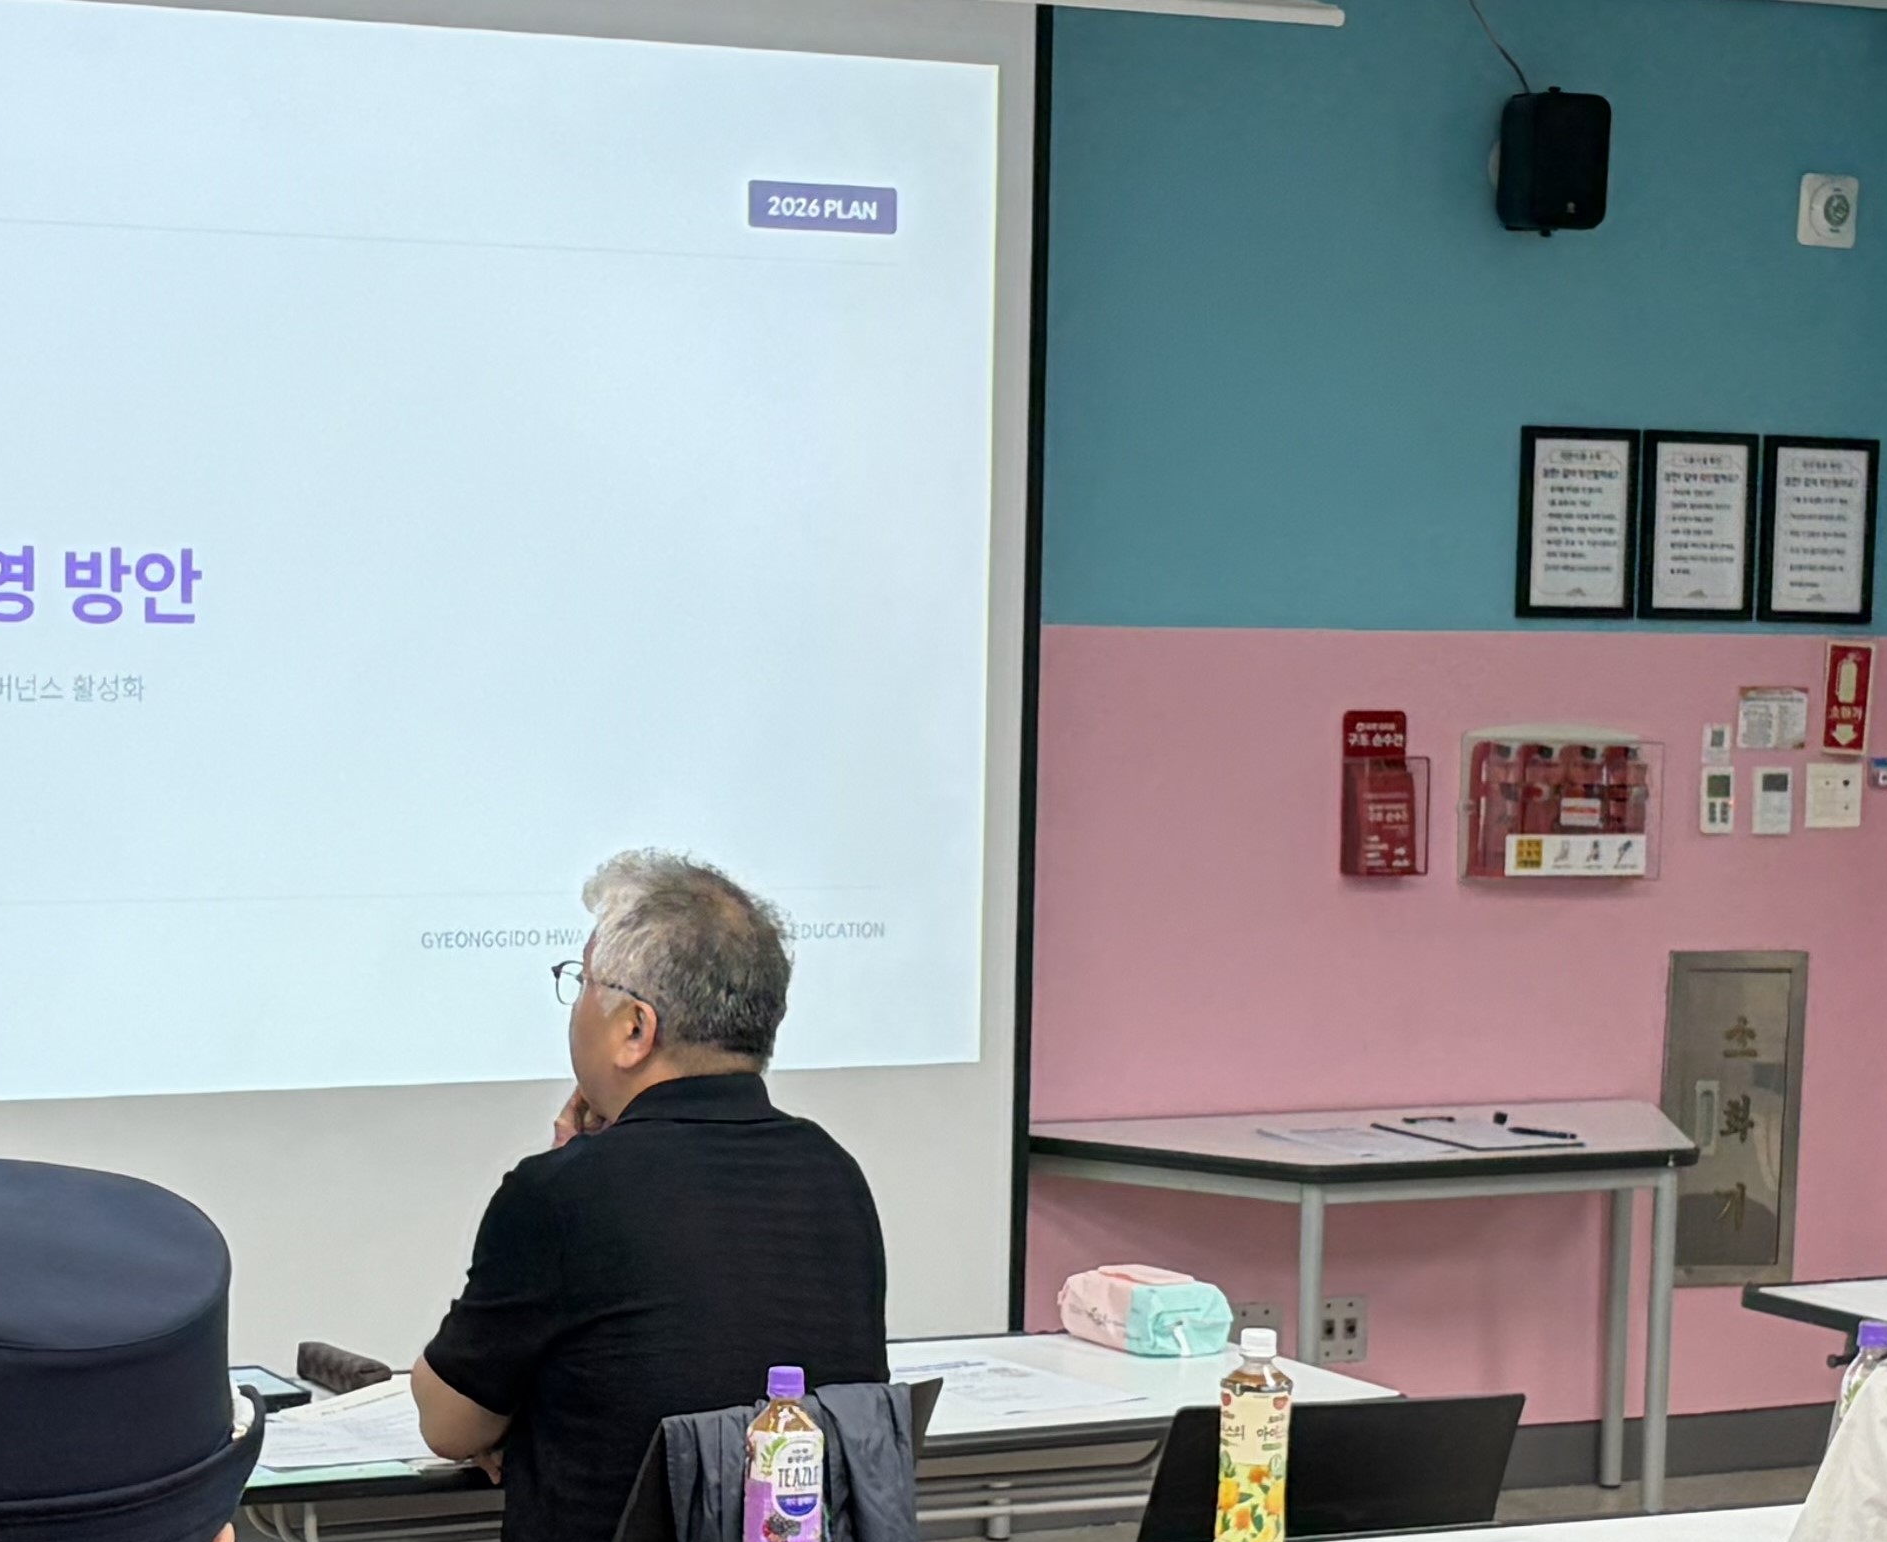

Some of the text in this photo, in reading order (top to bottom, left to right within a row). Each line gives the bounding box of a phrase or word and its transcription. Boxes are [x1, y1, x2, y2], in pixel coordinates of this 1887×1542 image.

[768, 196, 877, 220] 2026 PLAN
[64, 546, 203, 625] 방안
[72, 674, 145, 703] 활성화
[420, 928, 585, 949] GYEONGGIDO HWA
